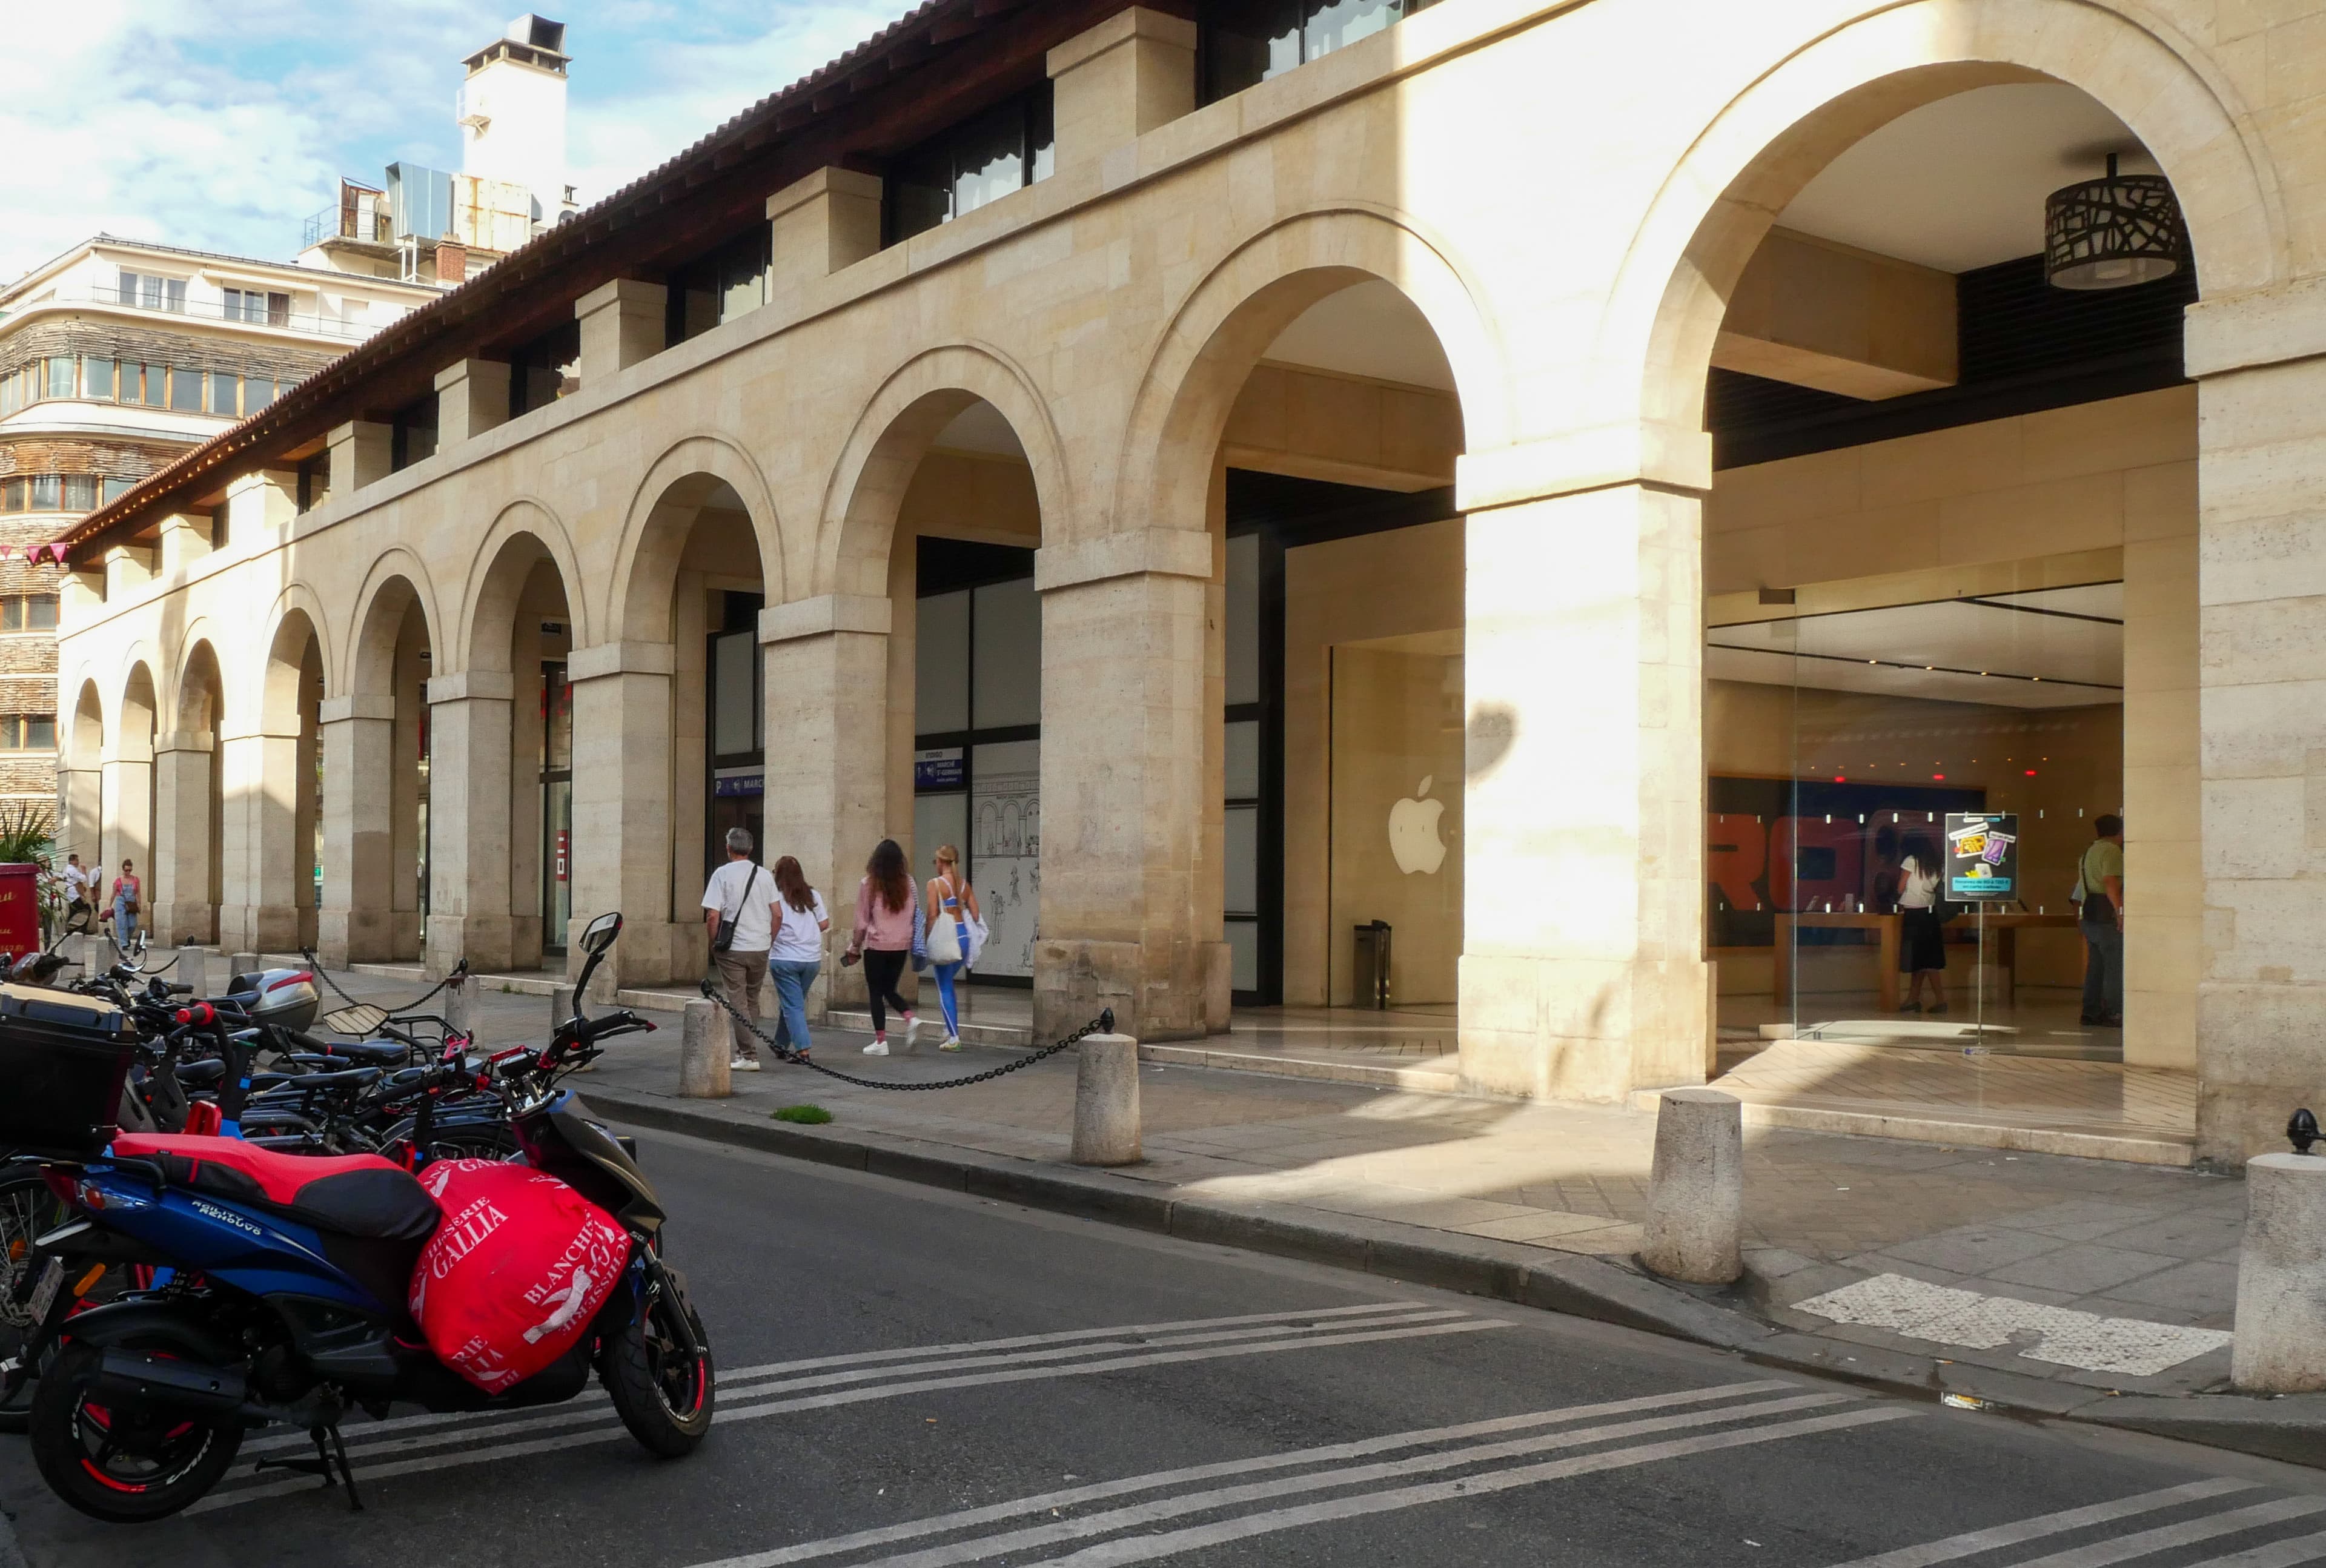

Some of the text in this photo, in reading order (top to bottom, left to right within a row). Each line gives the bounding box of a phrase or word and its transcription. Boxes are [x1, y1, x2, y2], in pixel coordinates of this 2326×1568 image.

[744, 779, 764, 789] MARC
[432, 1205, 509, 1279] GALLIA
[451, 1335, 488, 1363] RIE
